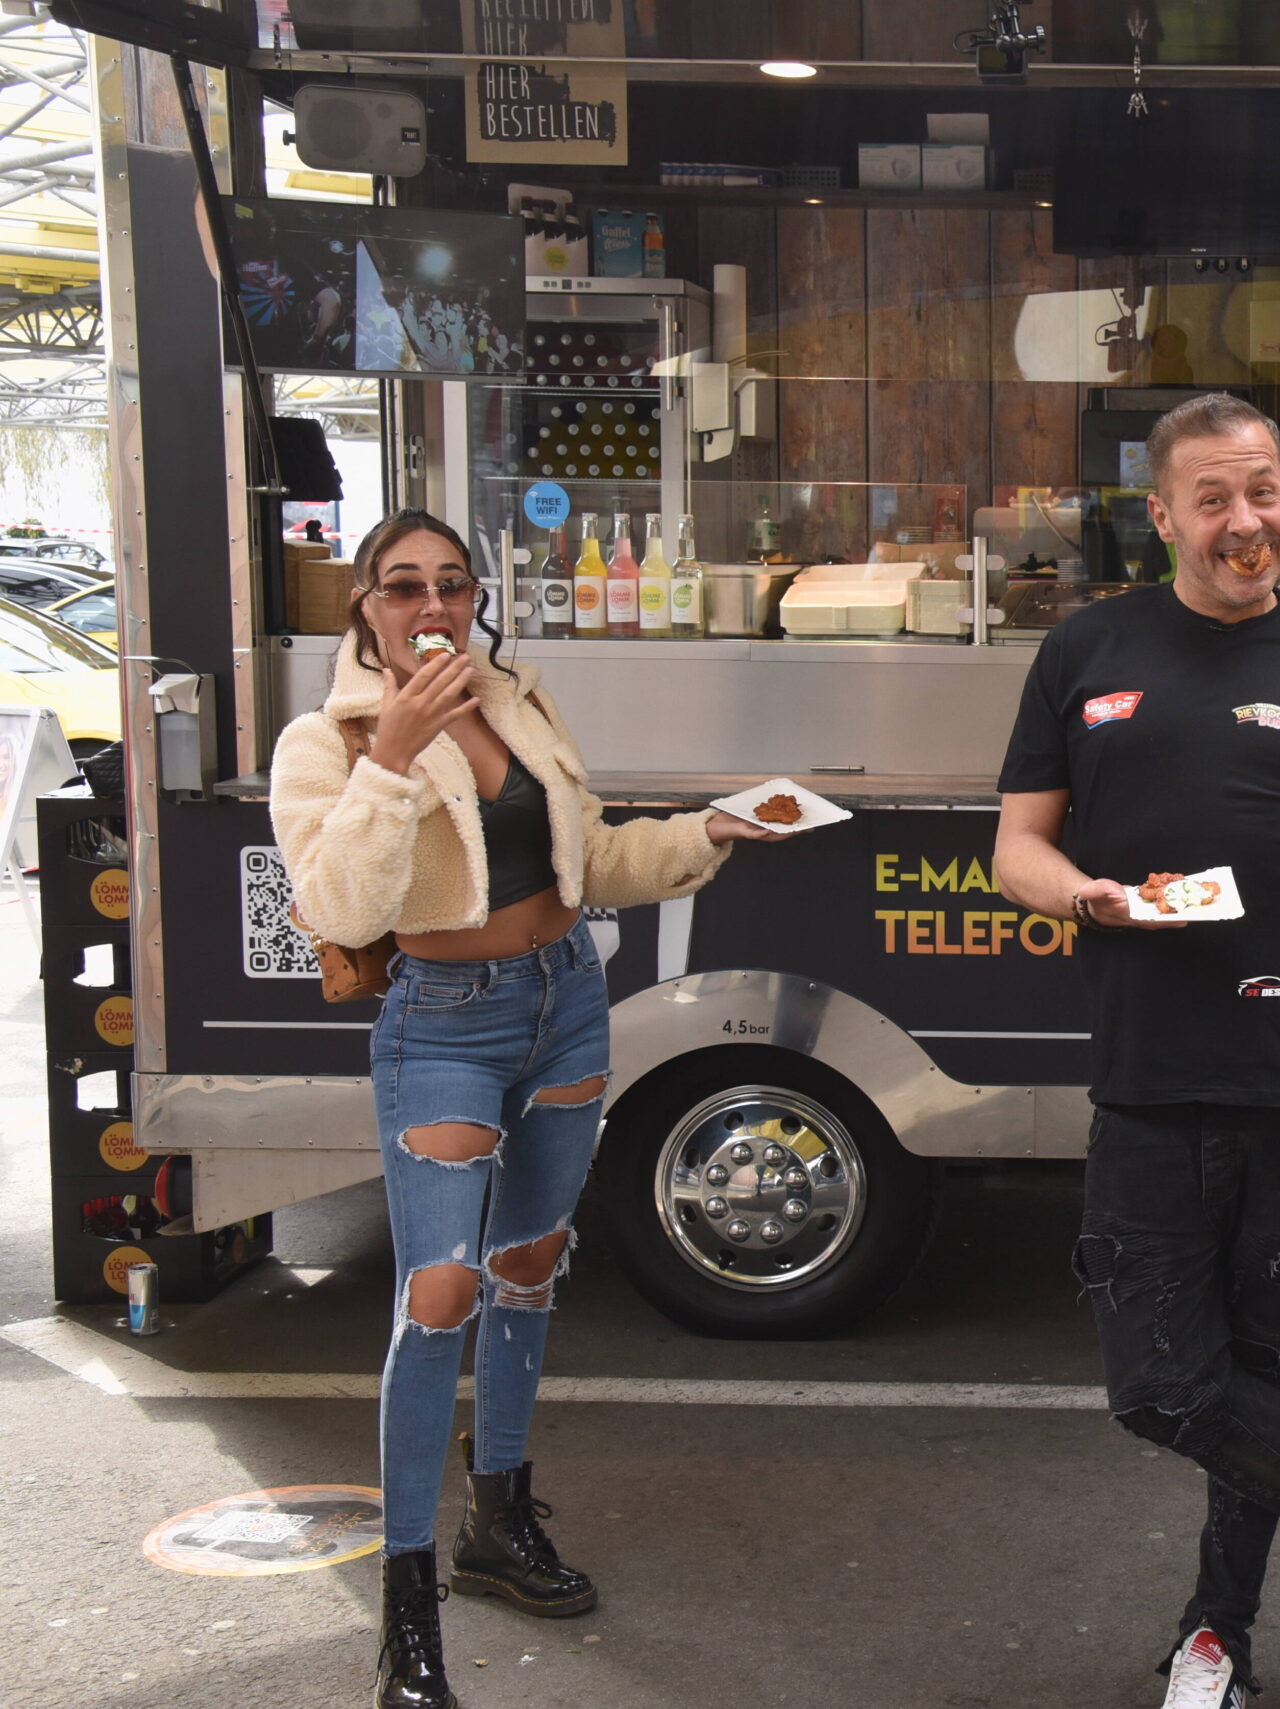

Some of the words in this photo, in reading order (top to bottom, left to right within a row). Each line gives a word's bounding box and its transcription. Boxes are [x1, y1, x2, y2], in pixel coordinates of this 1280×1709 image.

[486, 65, 530, 99] HIER
[486, 103, 599, 138] BESTELLEN
[536, 497, 562, 506] FREE
[536, 506, 558, 515] WIFI
[1084, 702, 1113, 714] Safety
[1115, 700, 1133, 710] Car
[876, 854, 1001, 893] E-MA
[95, 881, 129, 894] LÖMM
[1246, 988, 1260, 997] SE
[100, 1008, 133, 1021] LÖMM
[722, 1019, 747, 1036] 4,5
[749, 1024, 770, 1034] bar
